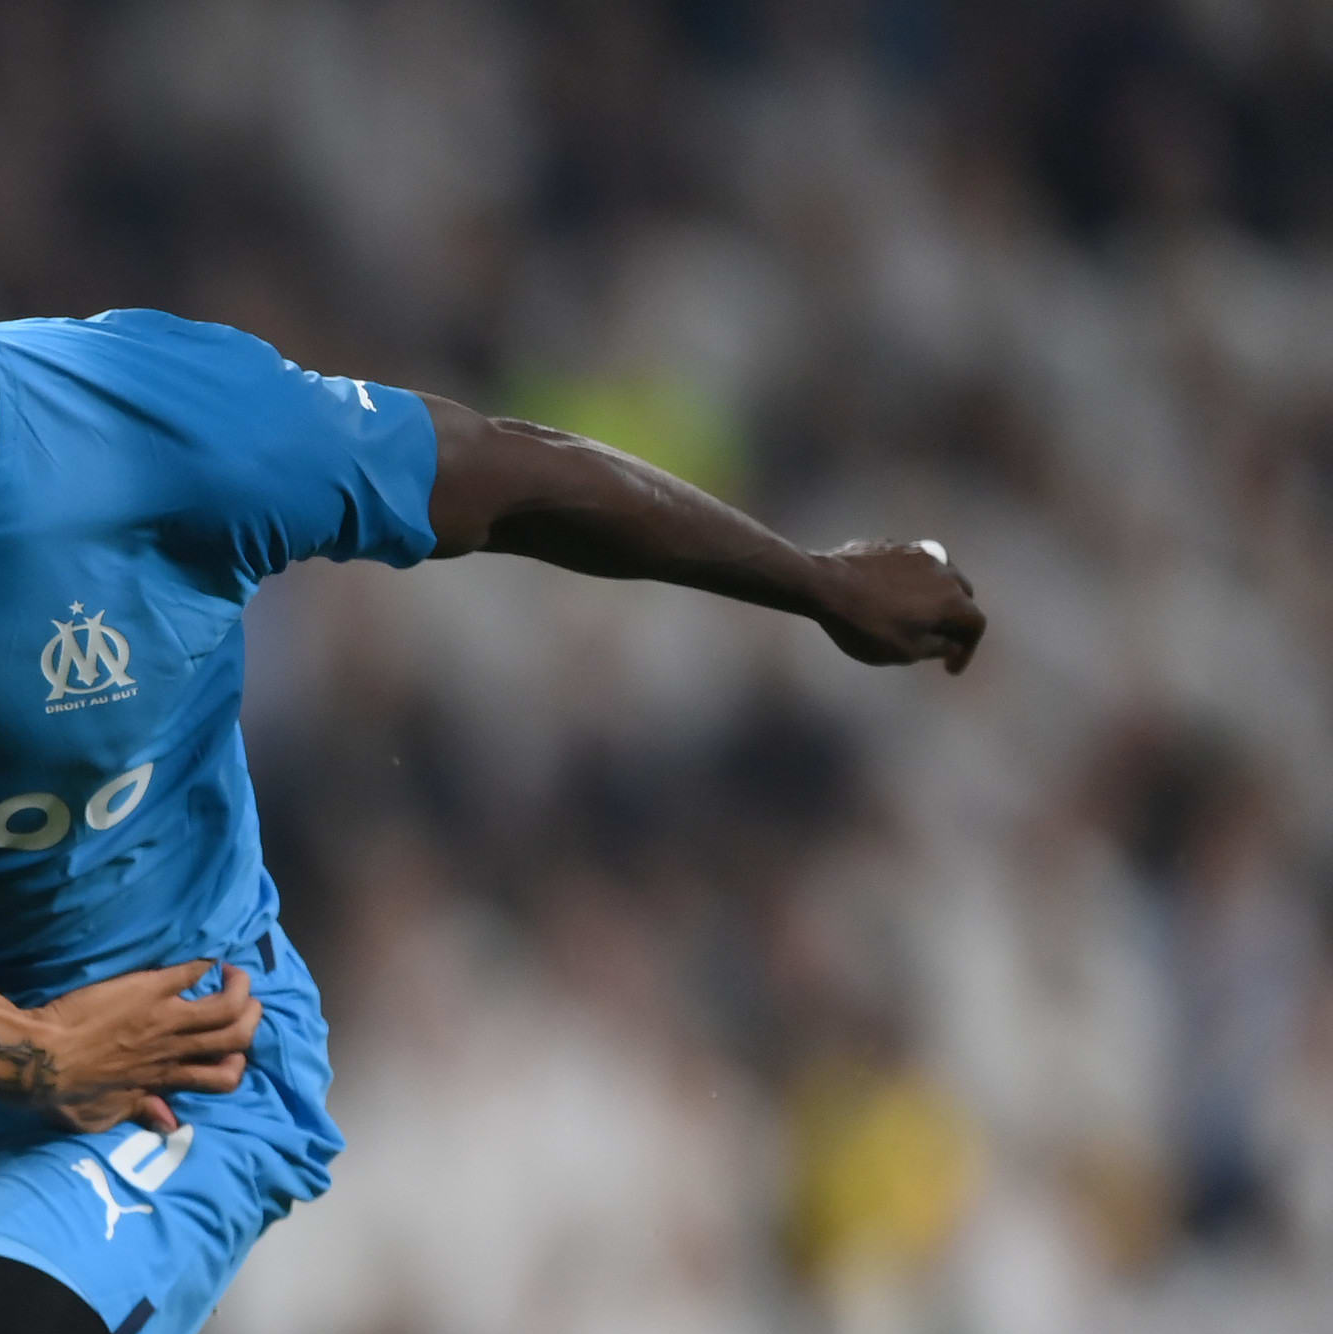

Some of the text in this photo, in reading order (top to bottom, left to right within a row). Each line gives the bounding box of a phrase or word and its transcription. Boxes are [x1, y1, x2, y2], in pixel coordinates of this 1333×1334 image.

[45, 687, 139, 714] DROIT AU BUT
